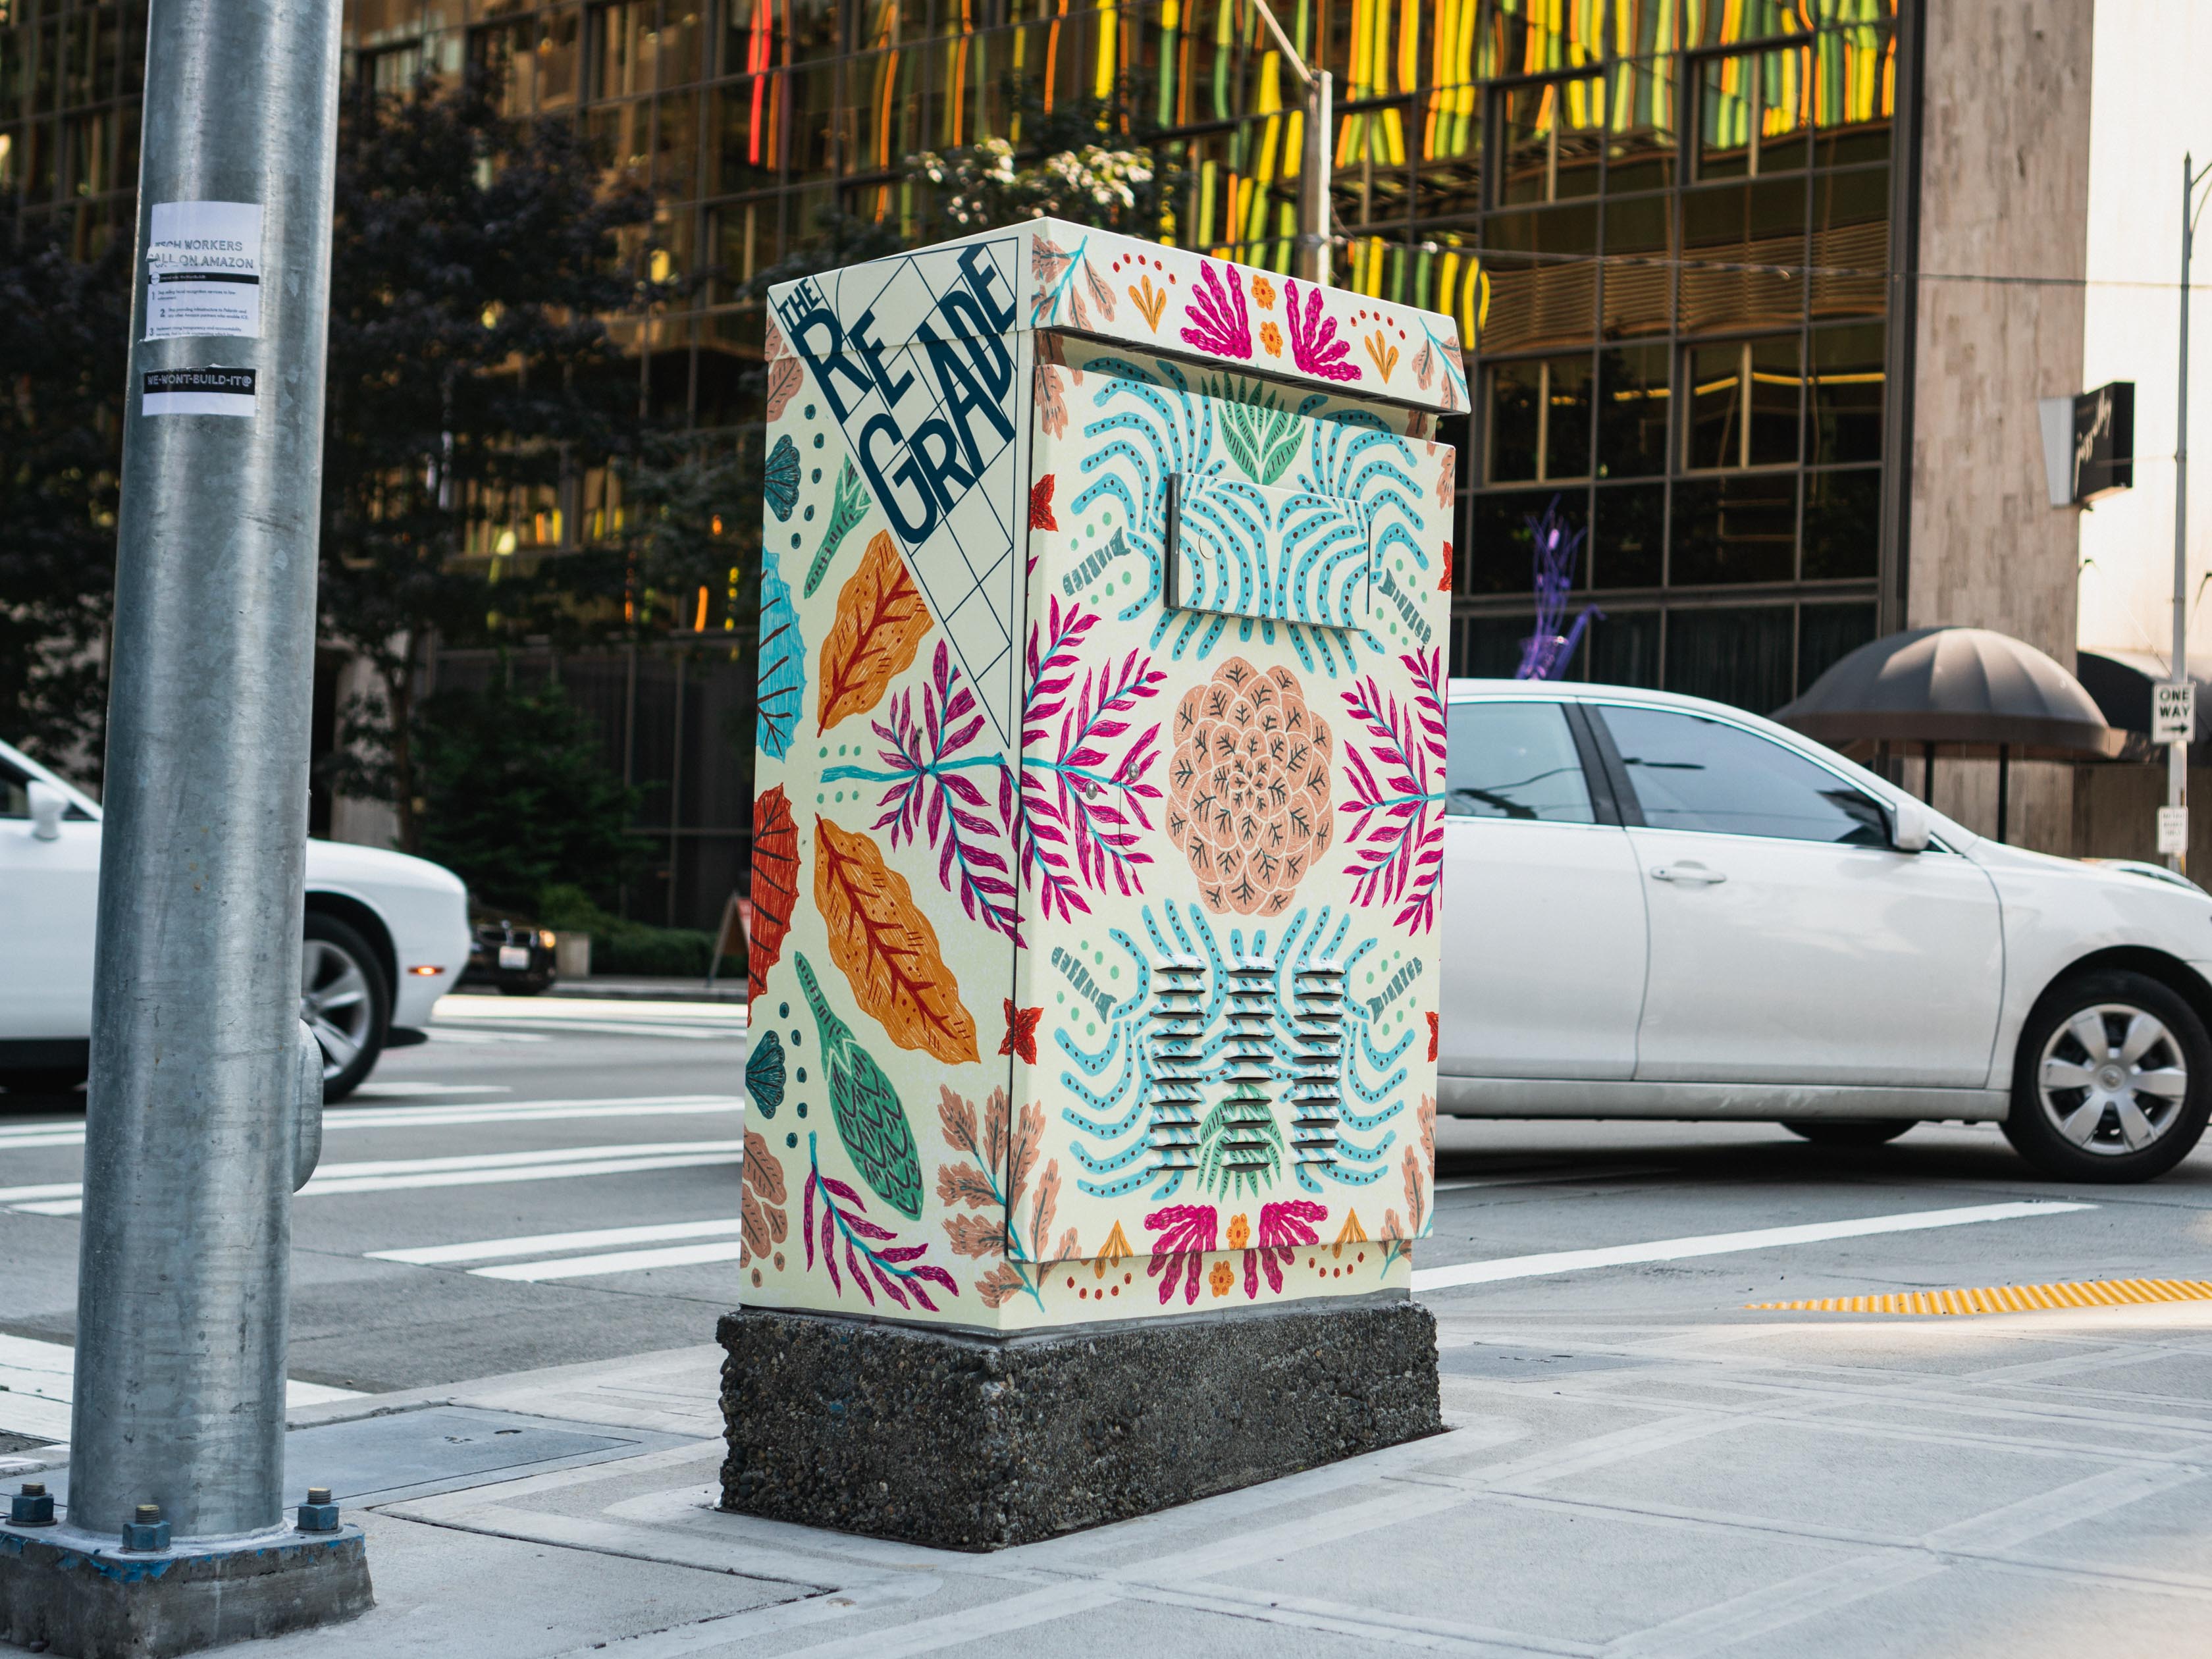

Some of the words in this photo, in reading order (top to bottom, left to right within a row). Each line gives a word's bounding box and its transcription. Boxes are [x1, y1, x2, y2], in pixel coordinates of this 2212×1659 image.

[184, 240, 243, 251] WORKERS
[179, 254, 198, 267] ON
[201, 256, 253, 269] AMAZON
[151, 292, 155, 300] 1
[779, 278, 822, 333] THE
[160, 309, 165, 317] 2
[2160, 688, 2191, 702] ONE
[2159, 705, 2190, 718] WAY
